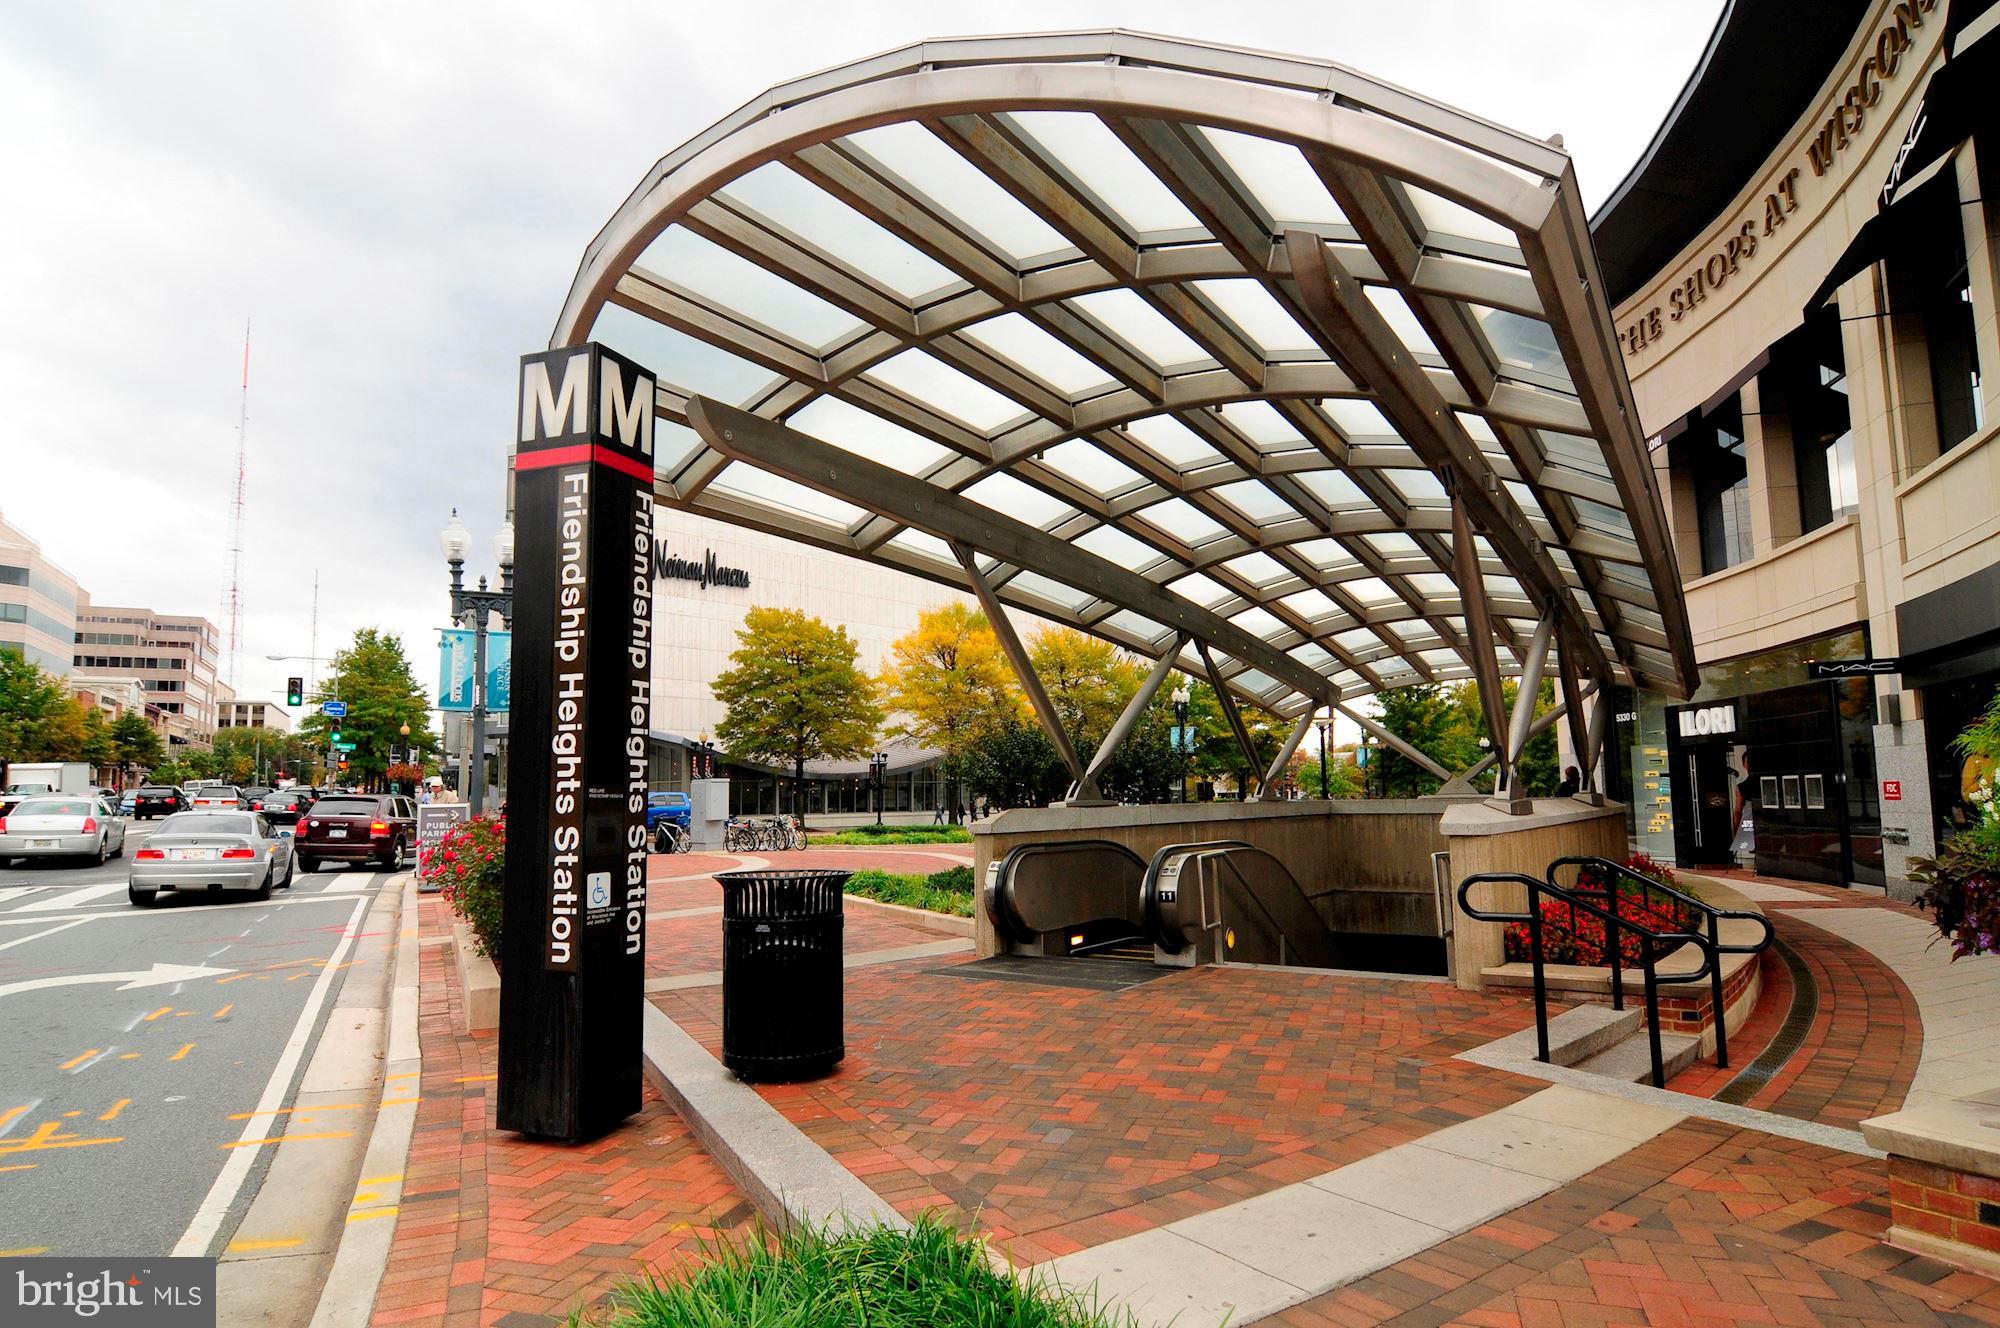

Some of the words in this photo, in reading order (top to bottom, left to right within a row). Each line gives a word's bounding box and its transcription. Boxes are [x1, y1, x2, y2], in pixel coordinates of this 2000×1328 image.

[1616, 307, 1664, 357] HE
[1669, 220, 1758, 322] SHOPS
[1763, 167, 1801, 238] AT
[1805, 0, 1936, 177] WISCON
[521, 353, 590, 443] M
[600, 354, 654, 457] M
[554, 473, 588, 662] Friendship
[628, 489, 654, 669] Friendship
[652, 539, 702, 582] Neiman
[700, 547, 751, 590] Marcus
[551, 673, 584, 815] Heights
[625, 680, 650, 814] Heights
[1615, 713, 1630, 723] 5330
[1631, 711, 1637, 721] G
[1679, 705, 1736, 737] ILORI
[1886, 783, 1898, 792] FDC
[551, 826, 580, 963] Station
[626, 824, 647, 955] Station
[1161, 891, 1173, 901] 11
